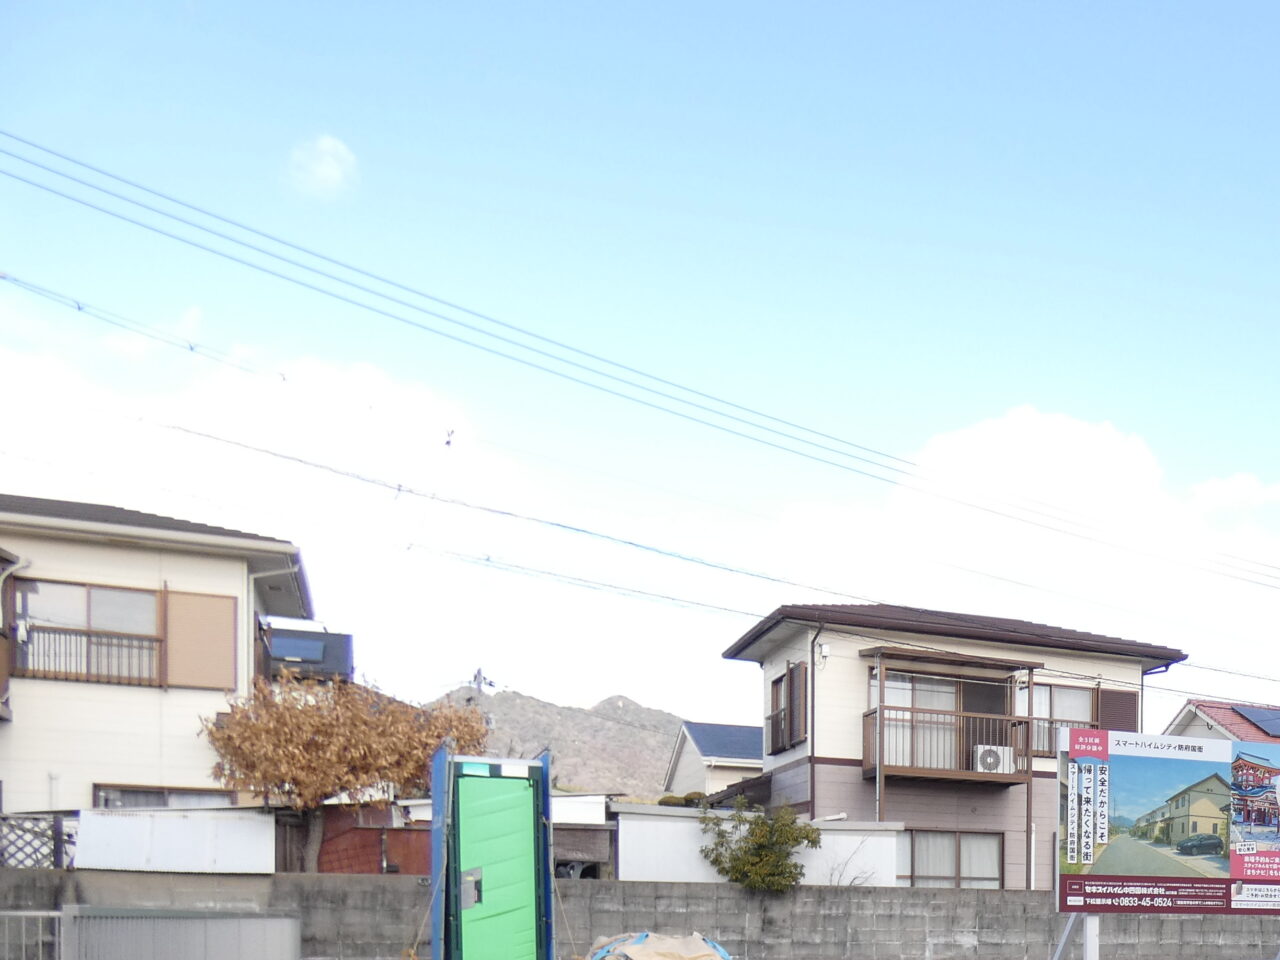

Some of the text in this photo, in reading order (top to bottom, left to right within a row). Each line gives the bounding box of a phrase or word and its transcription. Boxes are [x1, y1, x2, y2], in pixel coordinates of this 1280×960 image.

[1083, 765, 1093, 861] 帰って来たくなる街
[1098, 766, 1108, 842] 安全だからこそ
[1120, 896, 1172, 907] 0833-45-0524
